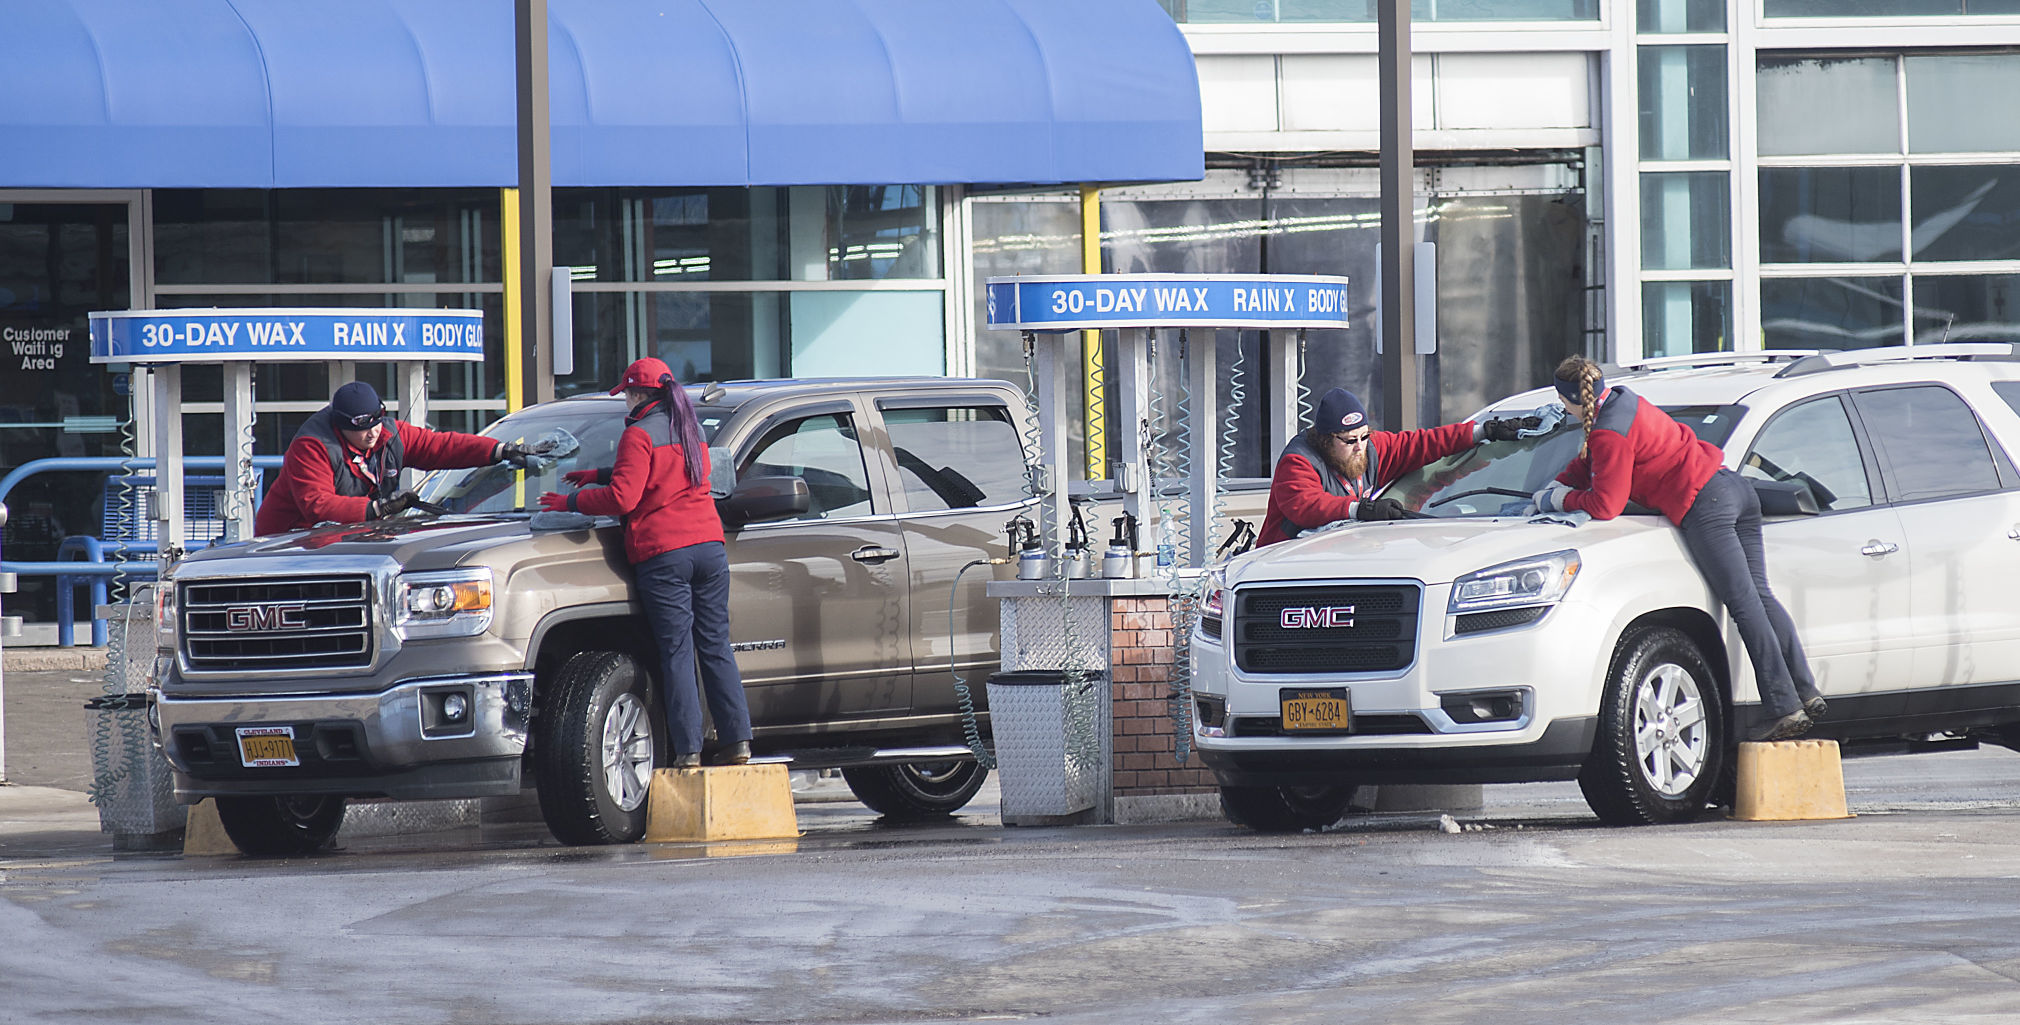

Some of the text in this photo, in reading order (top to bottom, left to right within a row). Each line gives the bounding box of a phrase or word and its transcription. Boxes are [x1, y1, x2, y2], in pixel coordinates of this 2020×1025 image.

[1052, 288, 1147, 313] 30-DAY
[1153, 287, 1209, 312] WAX
[1233, 288, 1280, 312] RAIN
[1284, 288, 1296, 312] X
[1308, 289, 1339, 313] BODY
[3, 326, 71, 341] Customer
[142, 322, 240, 347] 30-DAY
[246, 322, 306, 346] WAX
[333, 322, 388, 346] RAIN
[392, 322, 406, 346] X
[422, 323, 464, 347] BODY
[21, 356, 55, 370] Area
[226, 605, 306, 630] GMC
[1281, 605, 1355, 629] GMC
